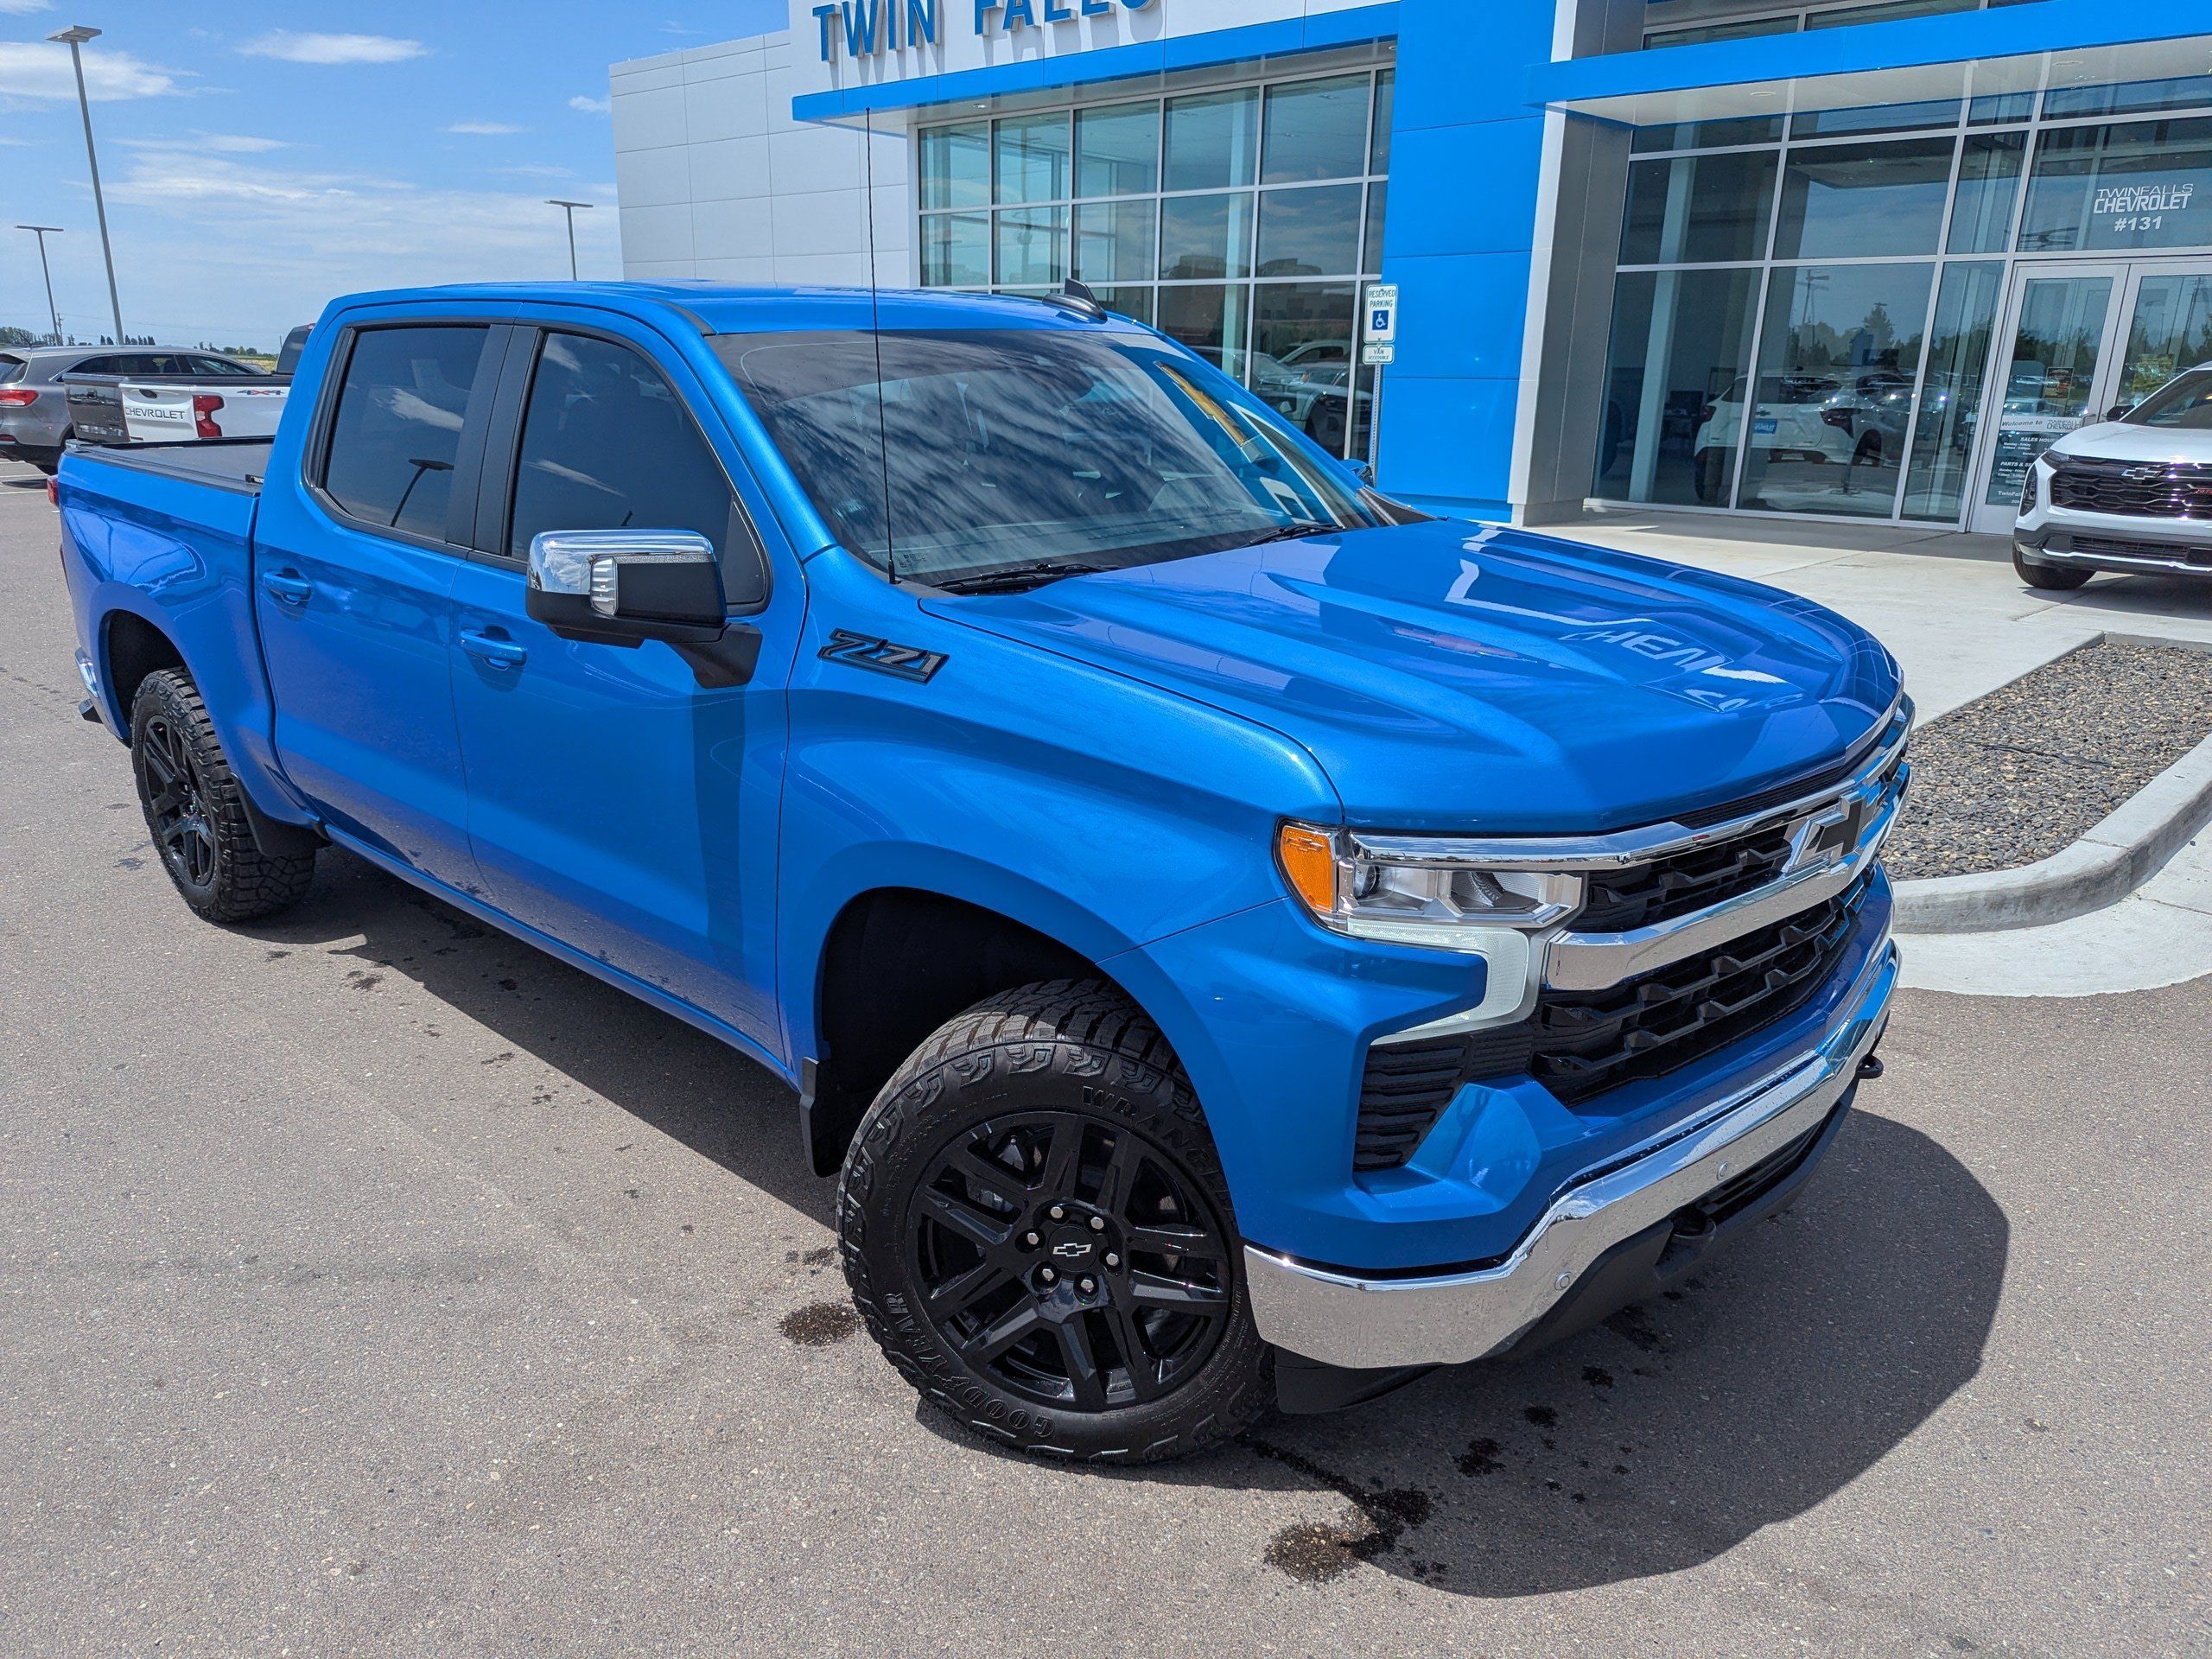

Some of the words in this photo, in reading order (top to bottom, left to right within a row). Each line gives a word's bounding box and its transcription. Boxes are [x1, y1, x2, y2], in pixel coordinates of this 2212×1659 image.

[812, 0, 941, 63] TWIN
[2094, 193, 2192, 214] CHEVROLET
[2114, 216, 2163, 232] #131
[1368, 289, 1395, 298] RESERVED
[1369, 300, 1394, 308] PARKING
[124, 406, 186, 420] CHEVROLET
[817, 627, 950, 685] Z71
